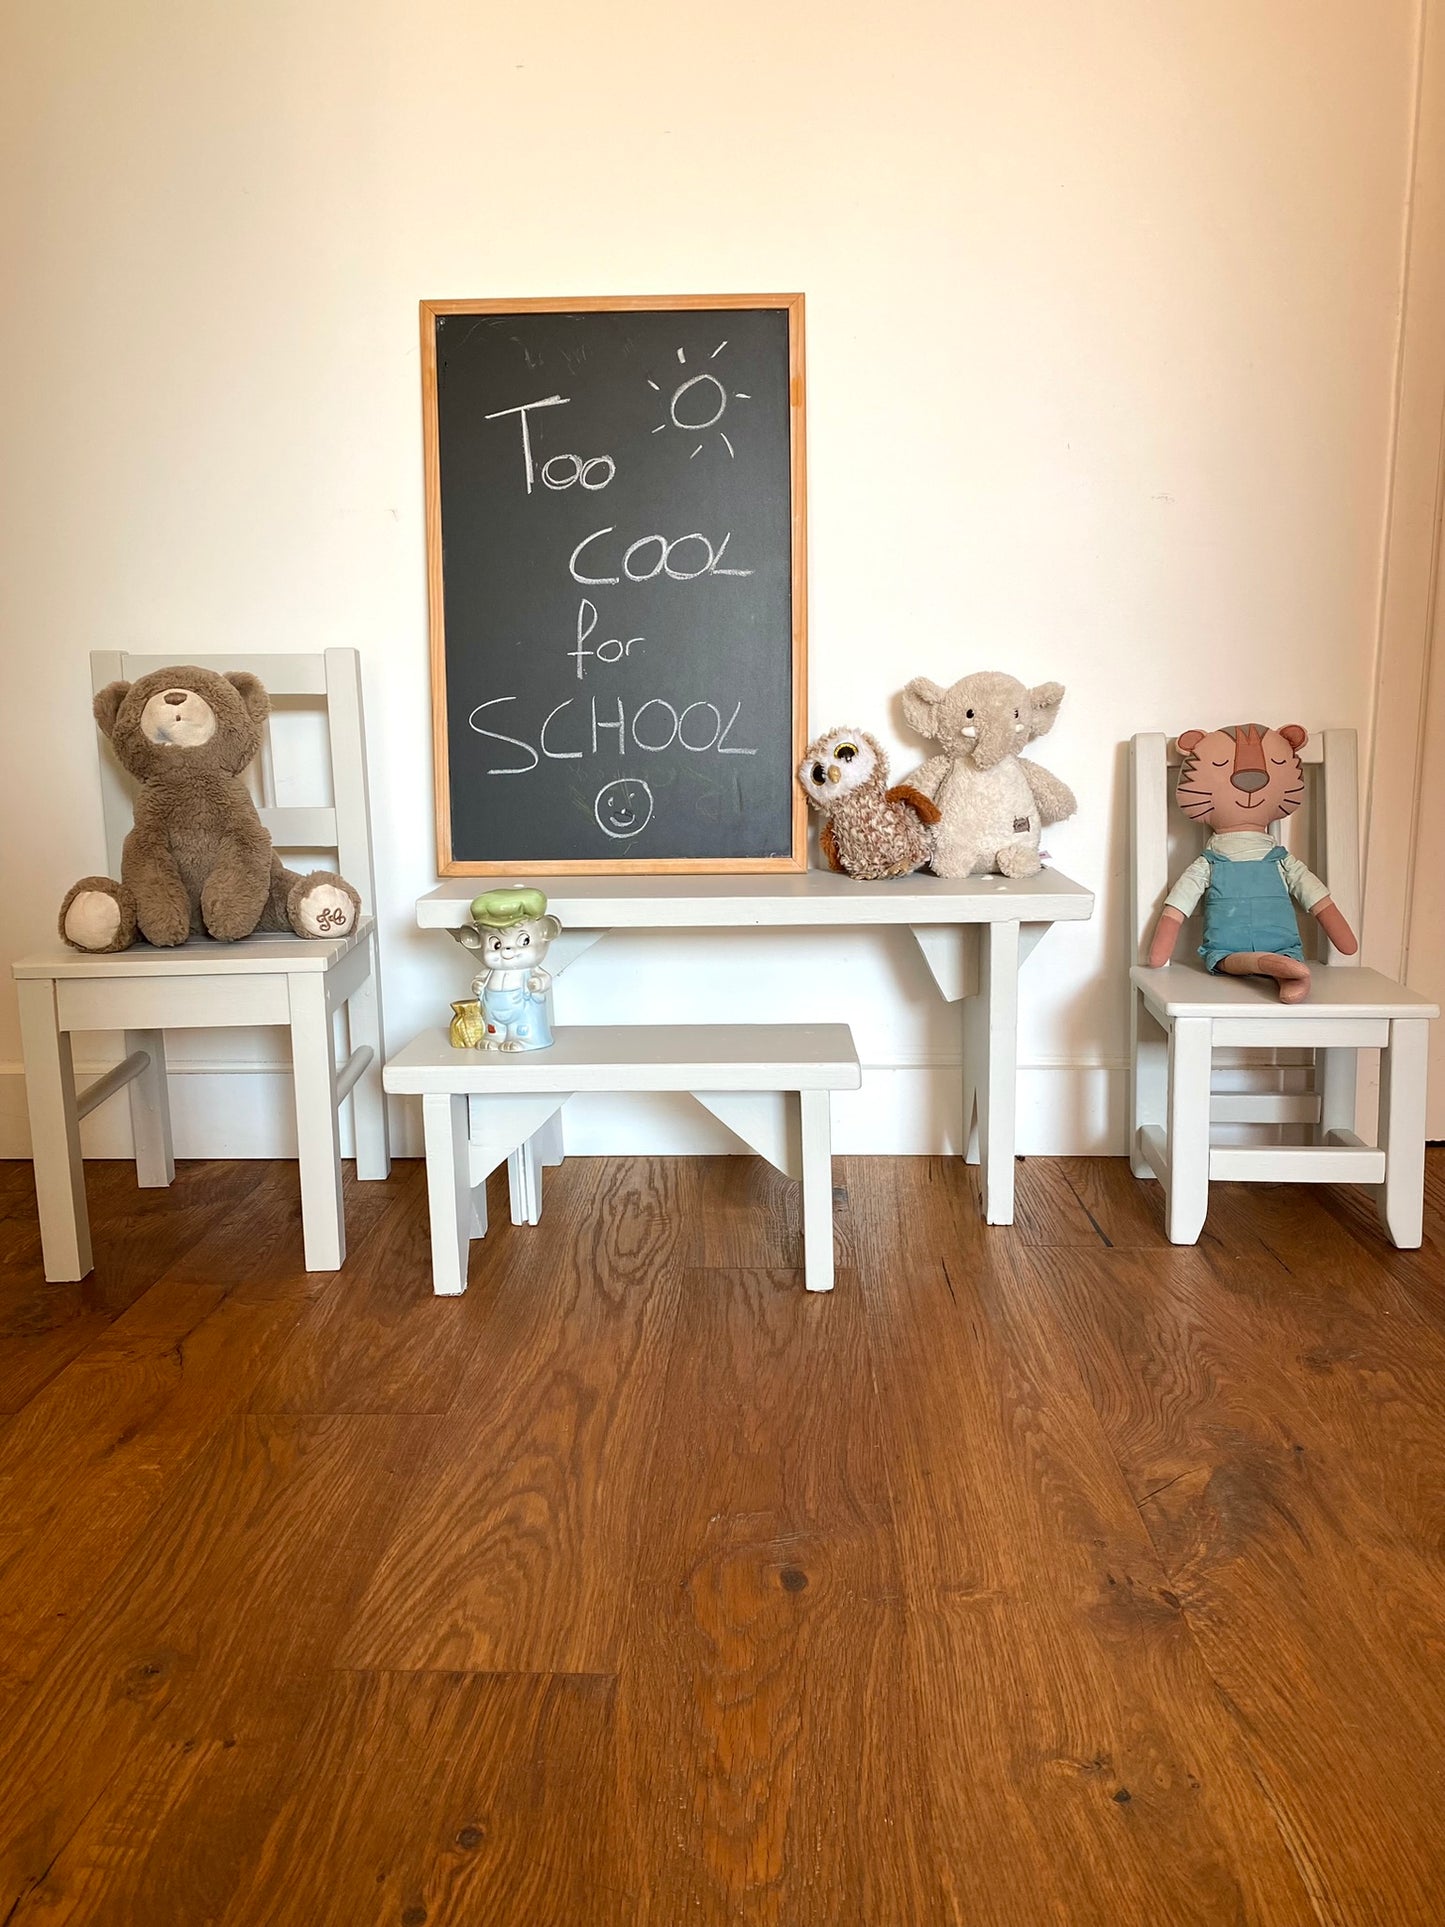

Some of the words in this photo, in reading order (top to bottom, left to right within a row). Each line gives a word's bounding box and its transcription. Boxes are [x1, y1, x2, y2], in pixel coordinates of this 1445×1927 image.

[485, 395, 616, 494] Too
[567, 598, 646, 680] for
[469, 696, 758, 775] SCHOOL
